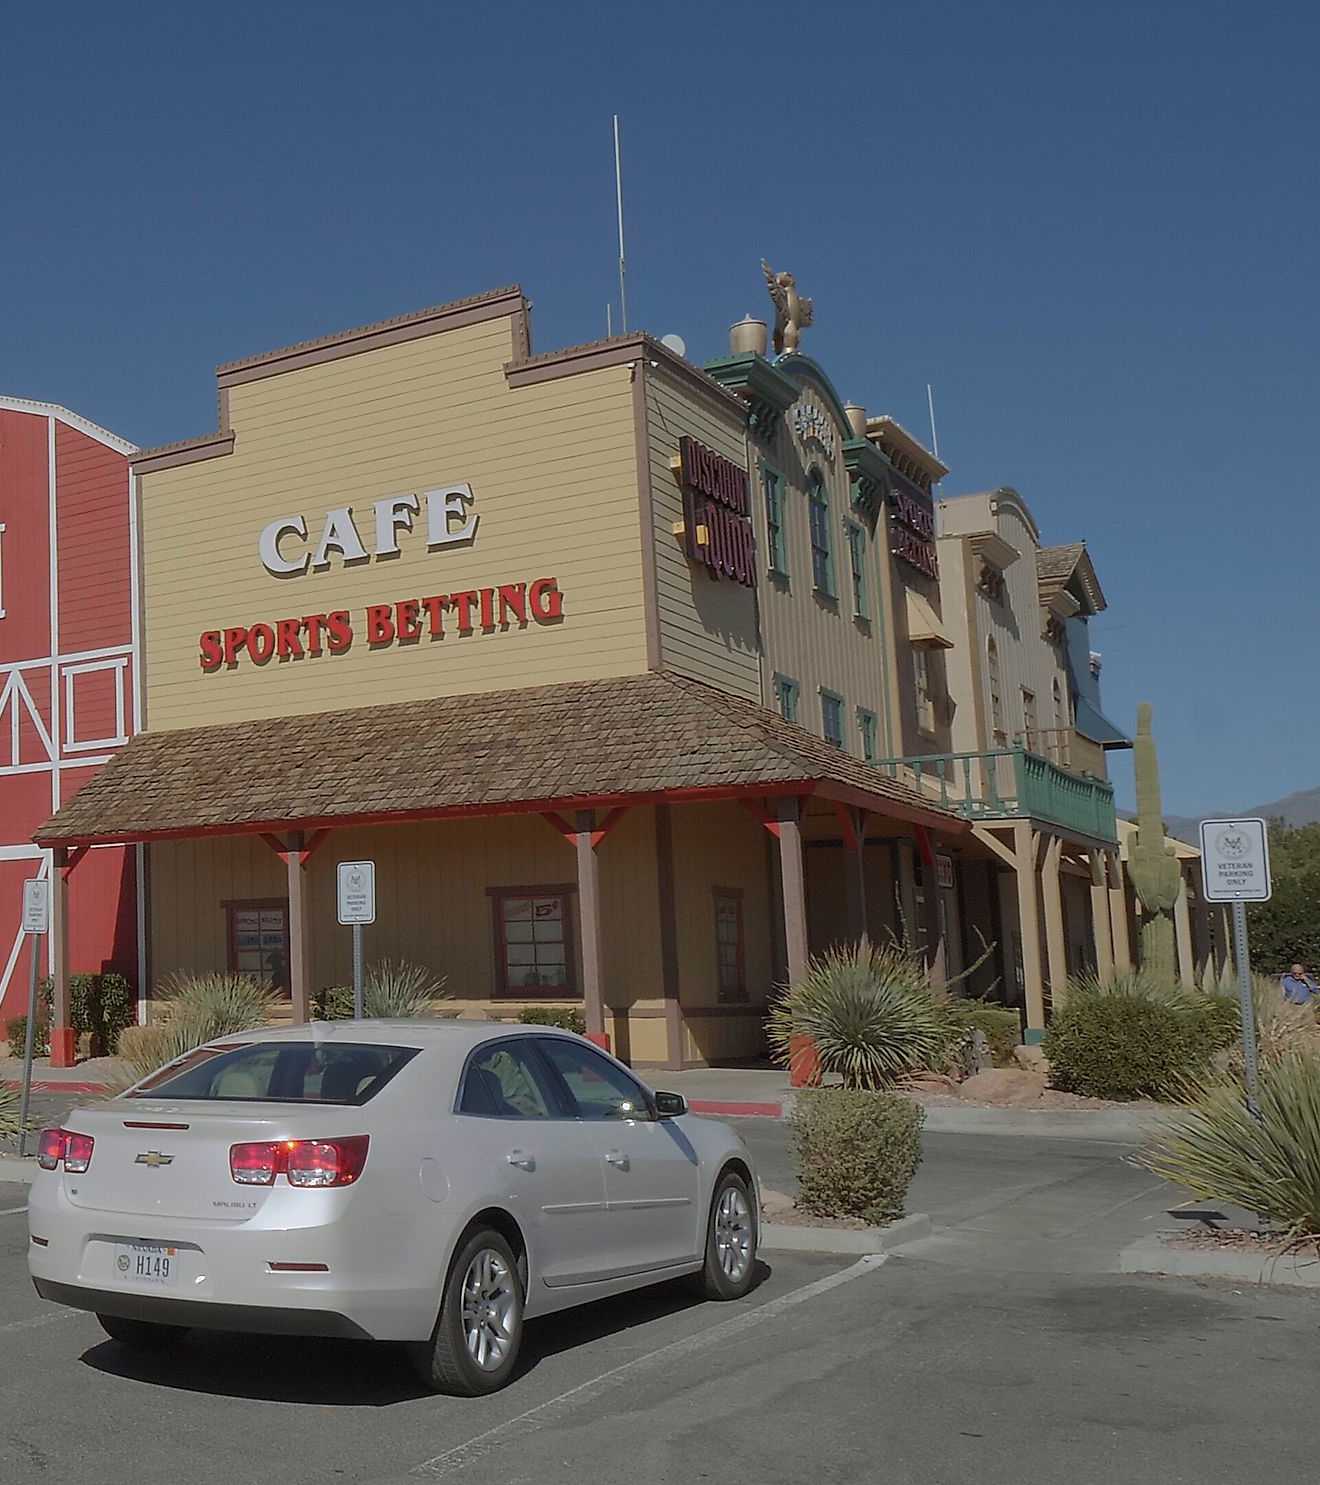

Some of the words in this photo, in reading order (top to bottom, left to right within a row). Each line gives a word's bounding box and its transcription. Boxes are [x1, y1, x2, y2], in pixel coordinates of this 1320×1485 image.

[259, 482, 479, 577] CAFE
[199, 610, 352, 671] SPORTS
[366, 577, 564, 646] BETTING
[136, 1255, 170, 1277] H149
